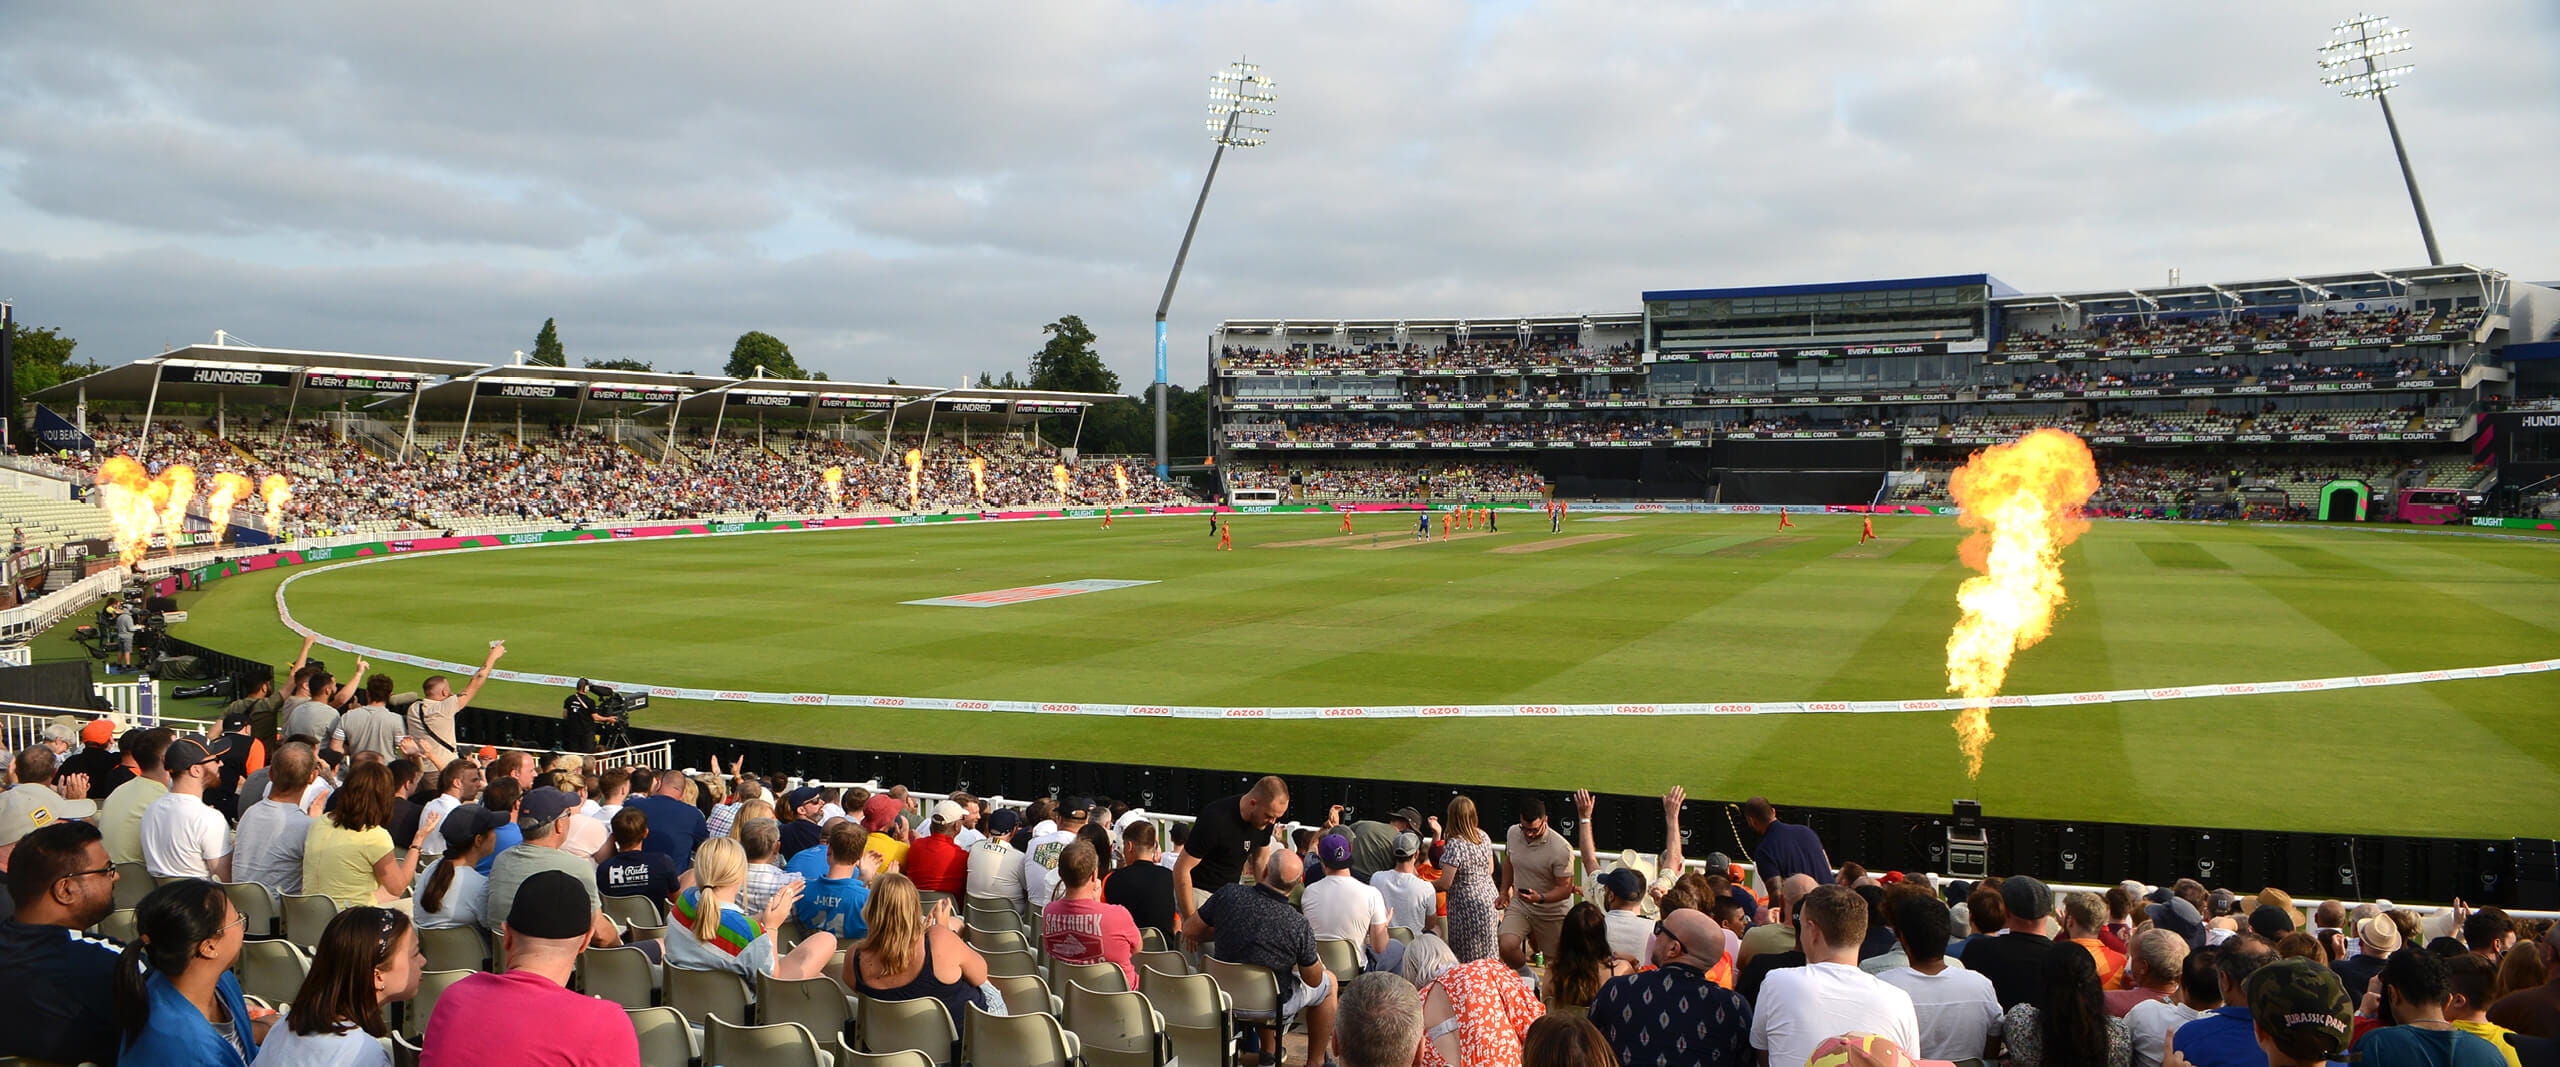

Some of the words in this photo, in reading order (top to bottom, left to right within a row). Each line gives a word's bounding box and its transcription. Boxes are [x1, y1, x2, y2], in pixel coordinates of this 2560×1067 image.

[194, 370, 262, 384] HUNDRED
[311, 376, 344, 387] EVERY.
[376, 380, 412, 391] COUNTS.
[501, 387, 556, 397] HUNDRED
[593, 390, 620, 399] EVERY.
[645, 392, 675, 401] COUNTS.
[747, 396, 791, 406] HUNDRED
[952, 404, 991, 412] HUNDRED
[2522, 415, 2560, 427] HUND
[43, 430, 58, 440] YOU
[901, 515, 927, 524] CAUGHT
[2472, 518, 2504, 527] CAUGHT
[716, 524, 744, 533] CAUGHT
[509, 534, 544, 544] CAUGHT
[308, 549, 332, 560] CAUGHT
[652, 688, 677, 696] CAZOO
[719, 691, 749, 699] CAZOO
[792, 695, 824, 703] CAZOO
[872, 698, 905, 706] CAZOO
[2073, 694, 2104, 702] CAZOO
[1042, 704, 1077, 712] CAZOO
[814, 896, 842, 908] J-KEY
[1046, 914, 1102, 936] SALTROCK
[2284, 1013, 2325, 1026] JURASSIC
